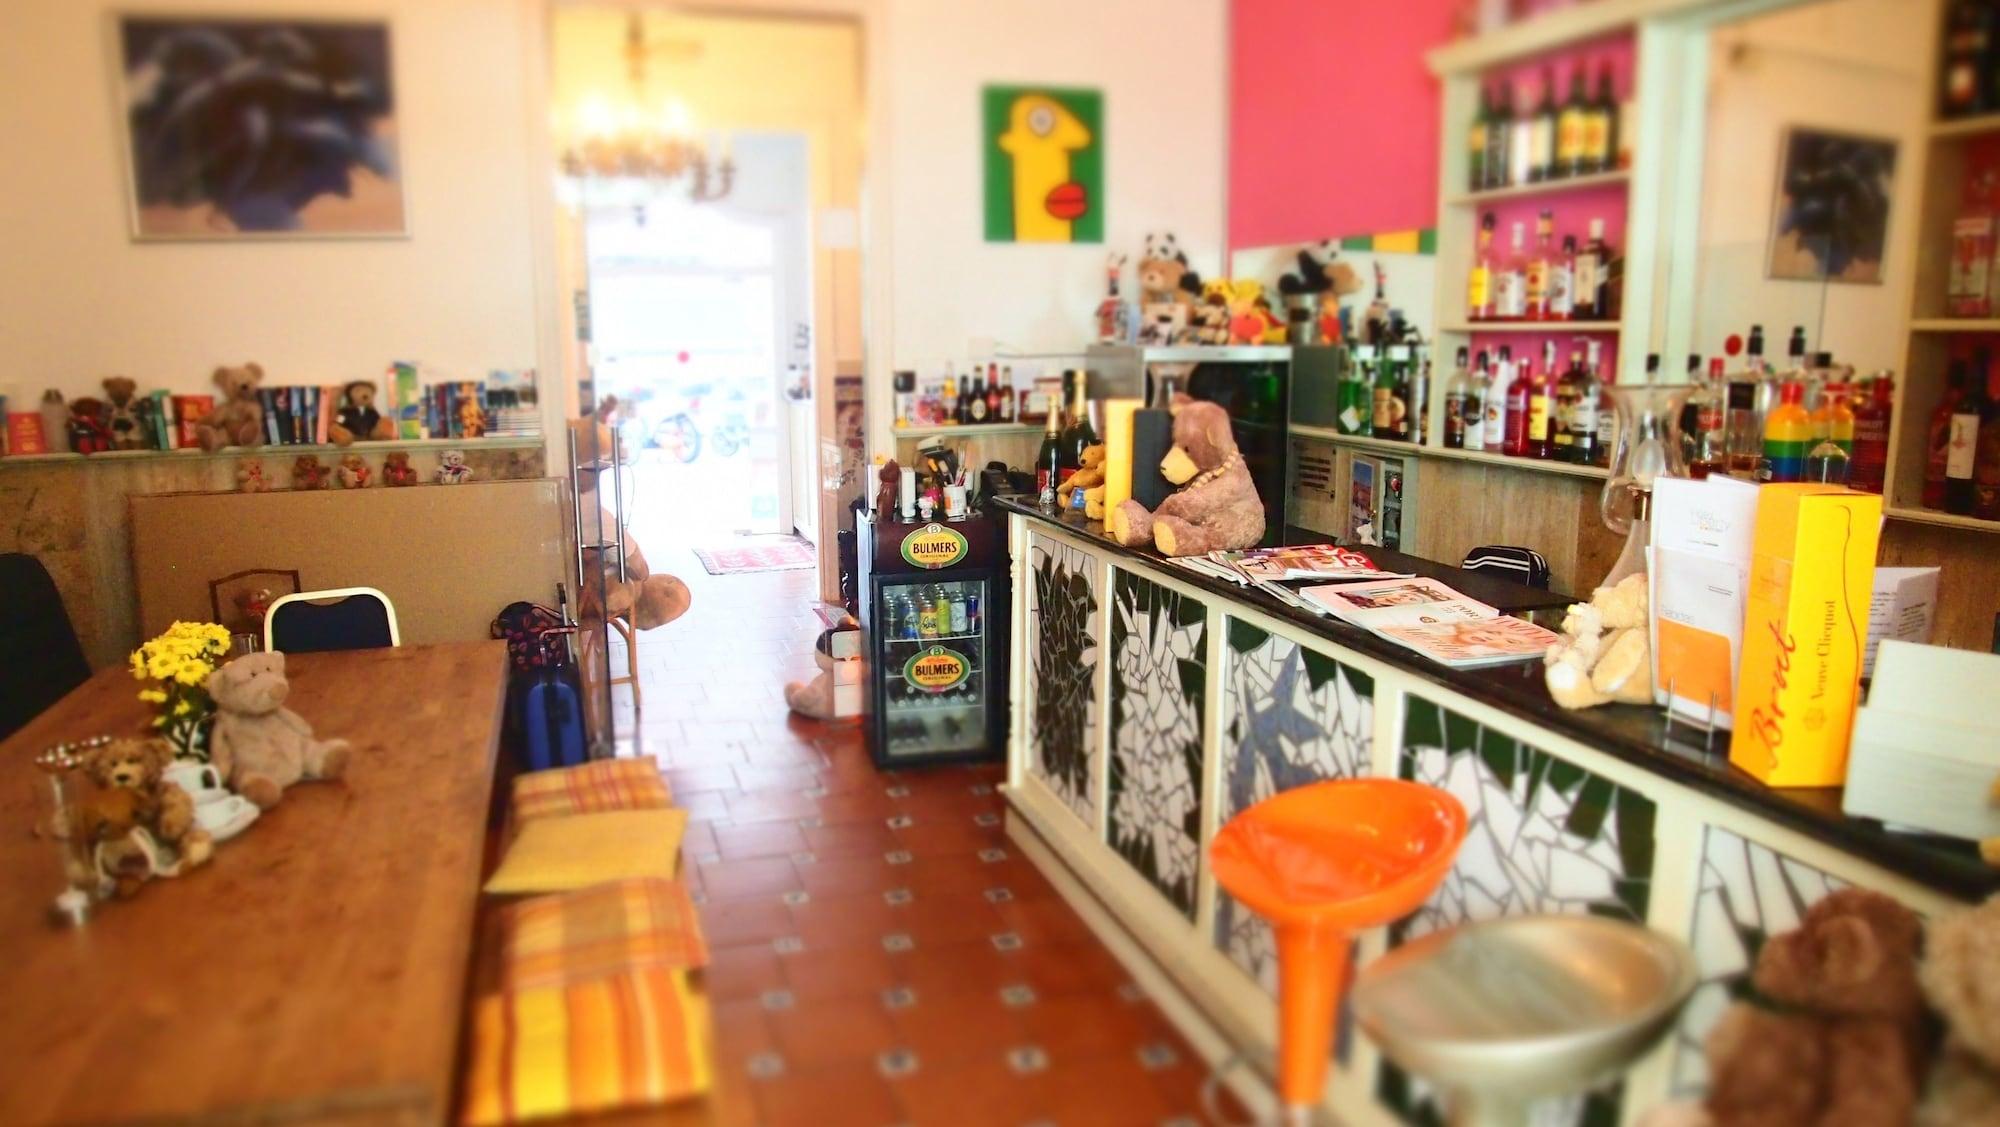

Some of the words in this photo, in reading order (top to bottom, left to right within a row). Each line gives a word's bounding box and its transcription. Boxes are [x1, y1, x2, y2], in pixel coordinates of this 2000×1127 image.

[913, 541, 958, 554] BULMERS
[1816, 600, 1837, 657] Clicquot
[915, 663, 960, 677] BULMERS
[1811, 660, 1829, 700] Veuve
[1750, 618, 1796, 769] Brut
